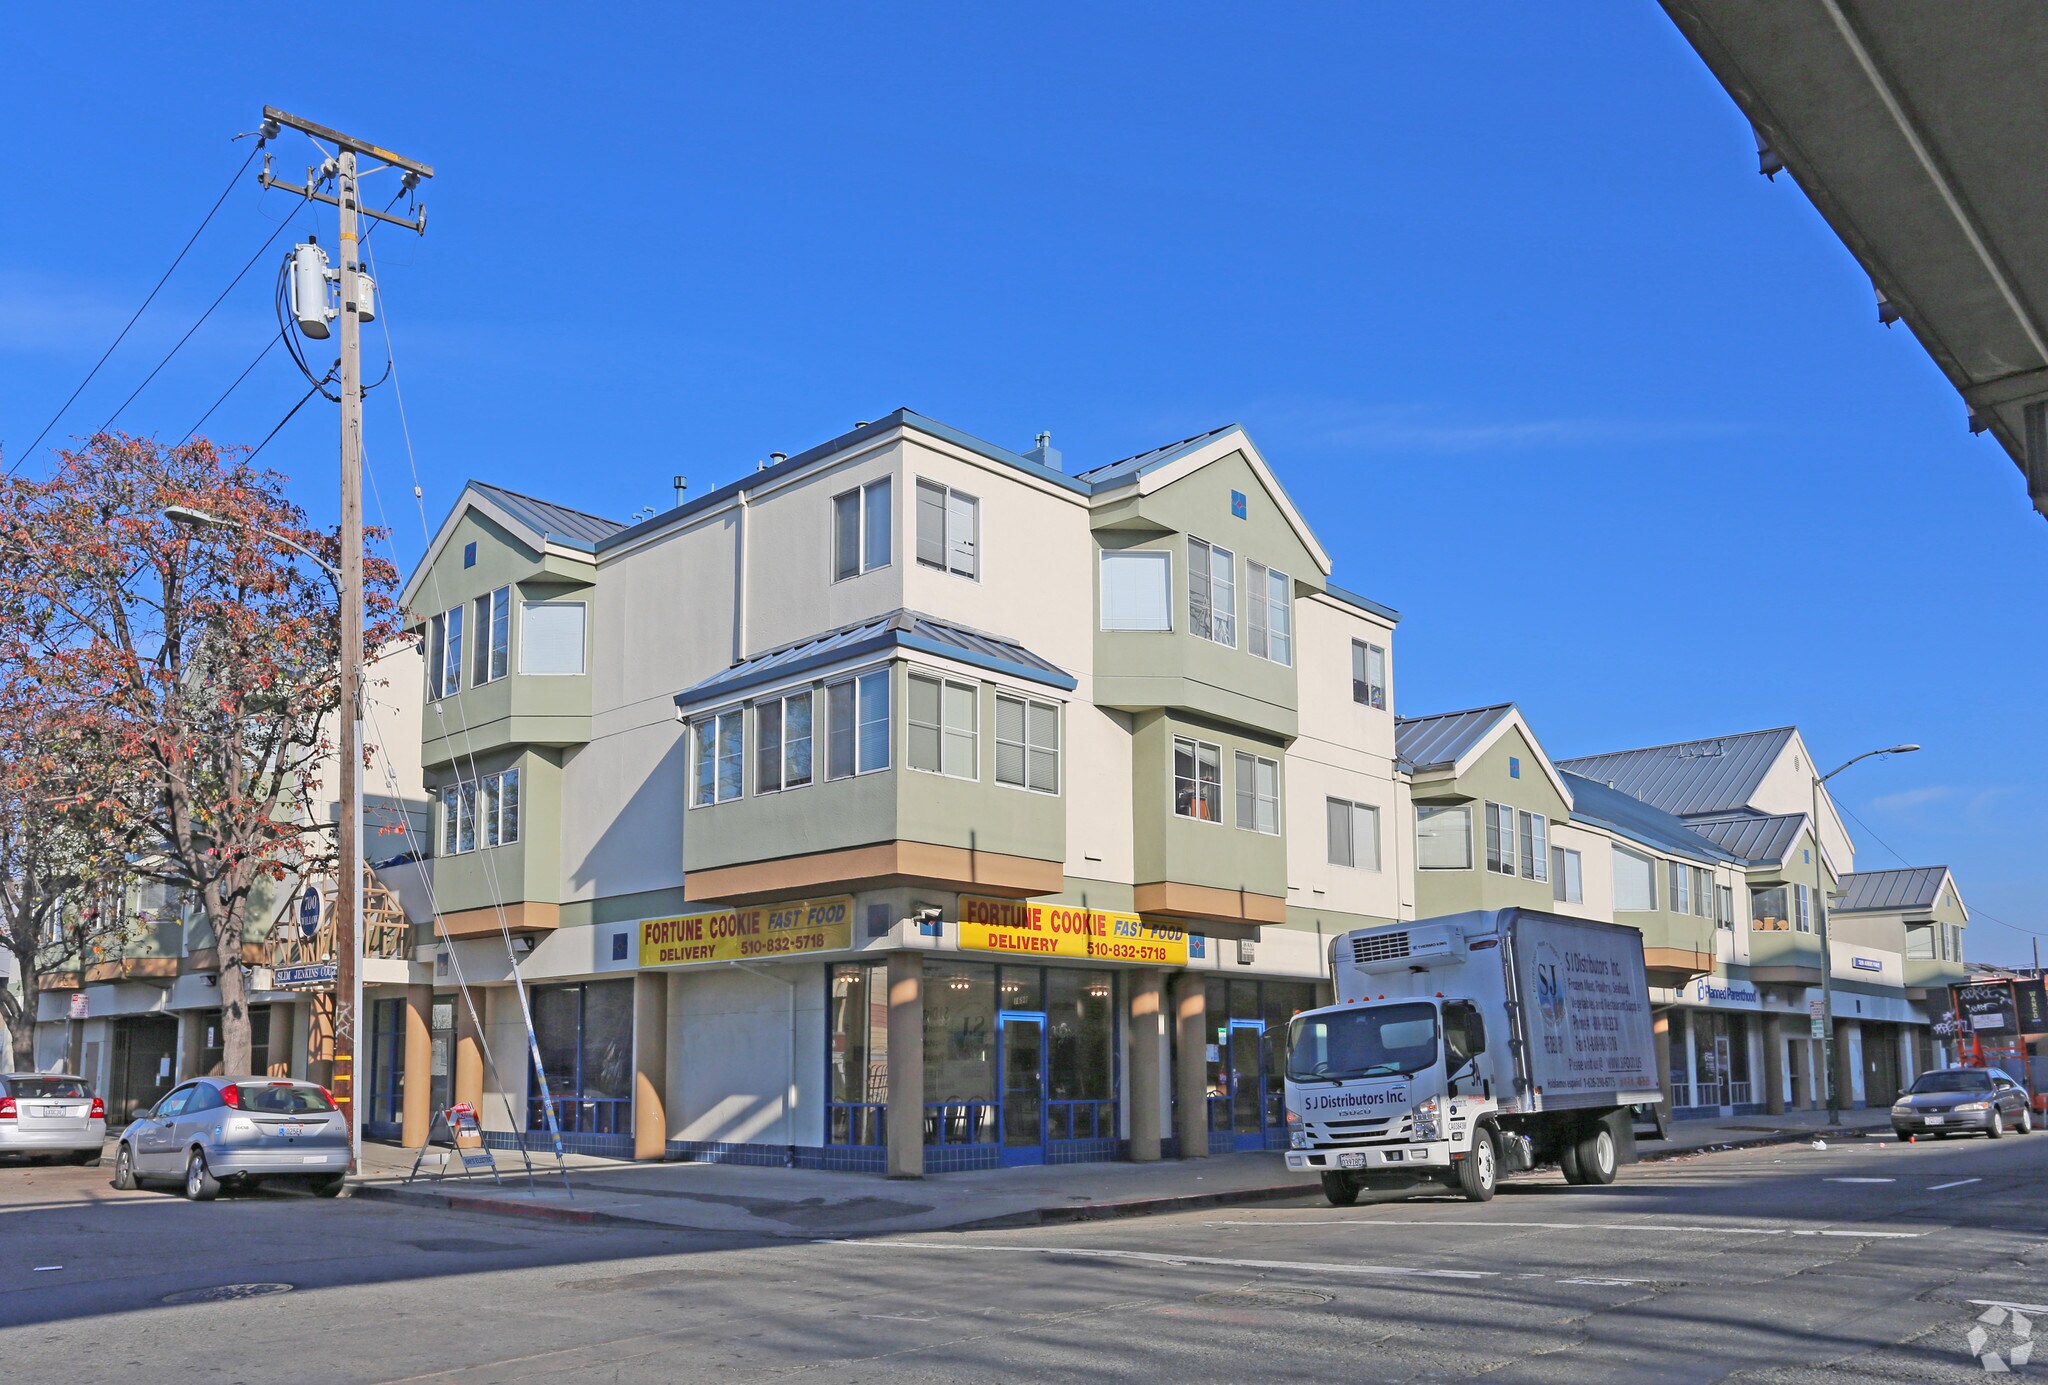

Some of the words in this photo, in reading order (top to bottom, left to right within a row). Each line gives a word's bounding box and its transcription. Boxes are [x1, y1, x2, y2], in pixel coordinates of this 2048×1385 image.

[305, 895, 317, 910] 700
[645, 918, 703, 945] FORTUNE
[709, 912, 760, 939] COOKIE
[768, 910, 802, 929] FAST
[807, 904, 846, 926] FOOD
[967, 901, 1042, 931] FORTUNE
[1050, 910, 1106, 937] COOKIE
[1113, 919, 1145, 937] FAST
[1150, 924, 1183, 941] FOOD
[659, 945, 716, 962] DELIVERY
[741, 933, 824, 955] 510-832-5718
[988, 933, 1058, 953] DELIVERY
[1087, 942, 1166, 961] 510-832-5718
[294, 968, 319, 979] JENKINS
[1574, 952, 1609, 975] Distributors
[1610, 957, 1621, 977] Inc.
[1538, 963, 1557, 996] SJ
[1705, 984, 1726, 1000] Planned
[1727, 987, 1757, 1002] Parenthood
[1305, 1097, 1312, 1110] S
[1313, 1097, 1318, 1110] J
[1320, 1093, 1384, 1109] Distributors
[1386, 1090, 1406, 1103] Inc.
[1338, 1108, 1371, 1117] ISUZU
